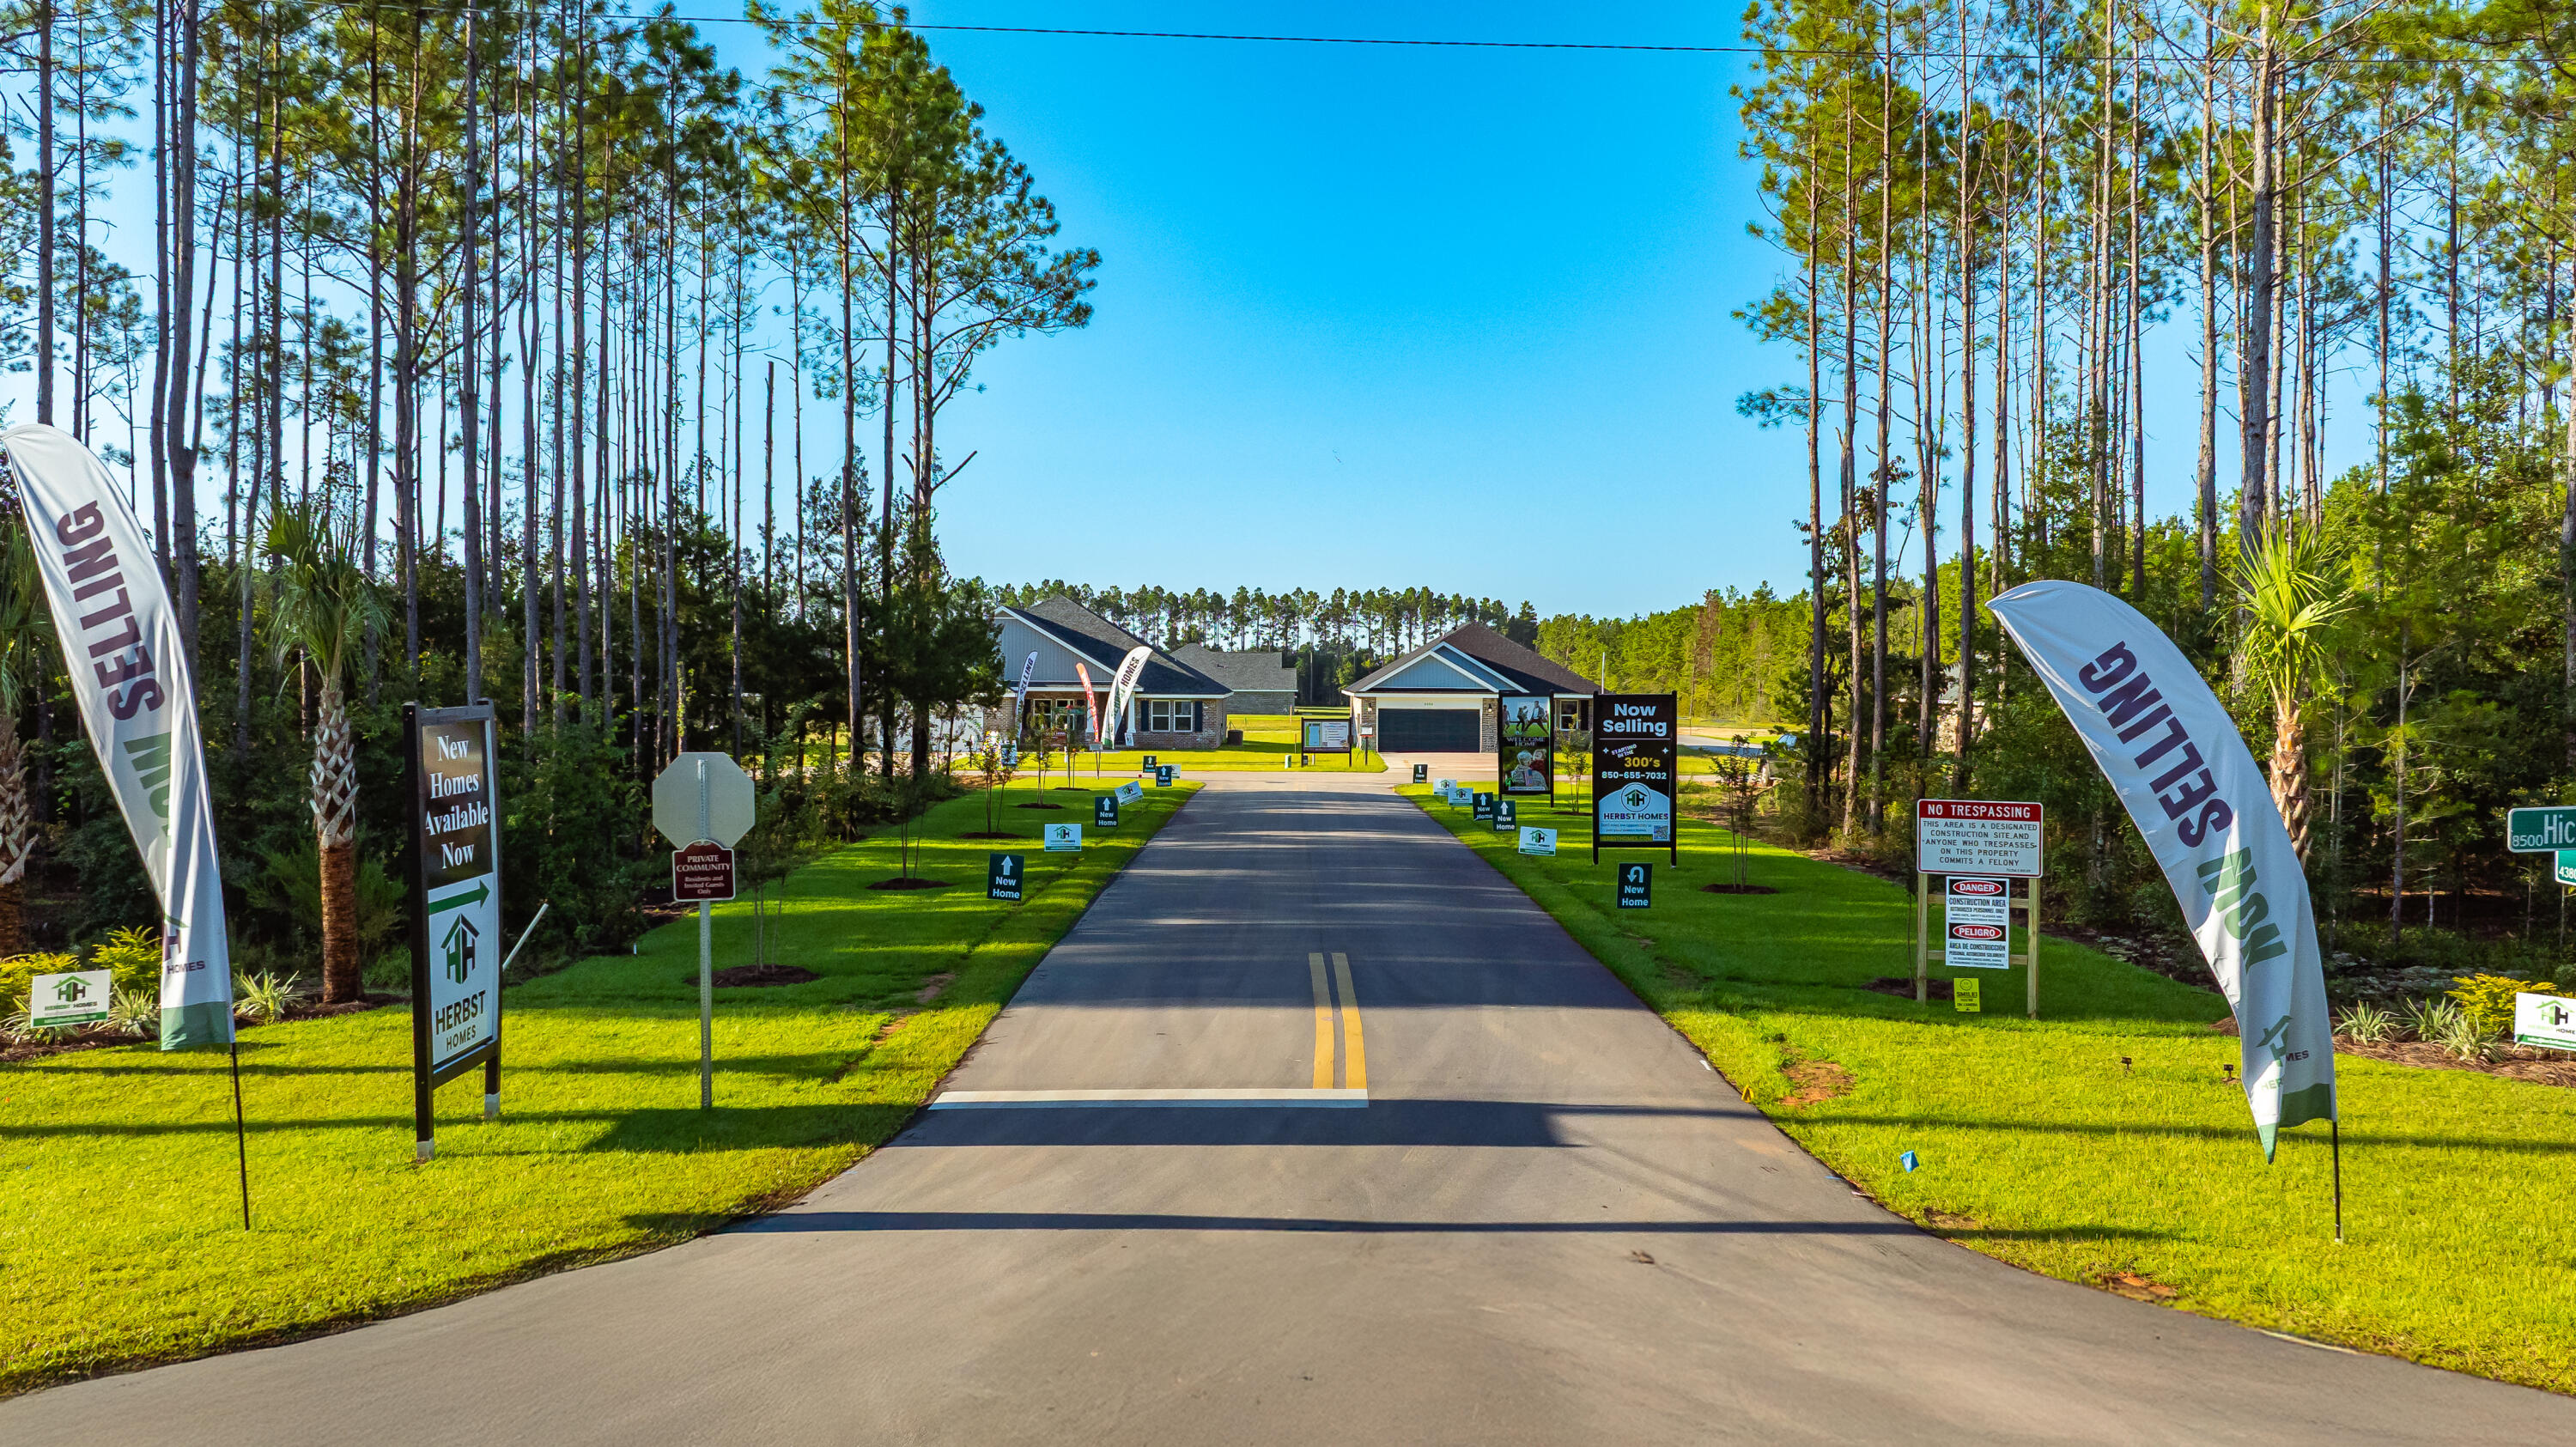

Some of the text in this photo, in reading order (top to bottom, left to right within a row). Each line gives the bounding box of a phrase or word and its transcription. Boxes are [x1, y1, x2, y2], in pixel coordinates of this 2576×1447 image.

[57, 500, 172, 839] OW SELLING
[1614, 703, 1656, 716] Now
[1602, 718, 1667, 737] Selling
[437, 735, 469, 762] New
[1624, 757, 1661, 768] 300's
[430, 772, 479, 799] Homes
[1928, 804, 2031, 818] NO TRESPASSING
[2078, 641, 2287, 975] NOW SELLING
[425, 800, 489, 836] Available
[1990, 823, 2038, 831] DESIGNATED
[2512, 814, 2576, 847] 8500 Hic
[1930, 830, 1989, 838] CONSTRUCTION
[1984, 840, 2035, 848] TRESPASSES
[440, 842, 475, 869] Now
[687, 854, 720, 863] PRIVATE
[676, 863, 731, 872] COMMUNITY
[996, 876, 1017, 886] New
[1625, 885, 1644, 894] New
[1959, 883, 1995, 892] DANGER
[993, 889, 1020, 899] Home
[1622, 897, 1649, 906] Home
[1948, 897, 1990, 906] CONSTRUCTION
[1959, 927, 1996, 937] PELIGRO
[435, 989, 486, 1035] HERBST
[447, 1024, 477, 1052] HOMES
[2286, 1049, 2309, 1062] MES
